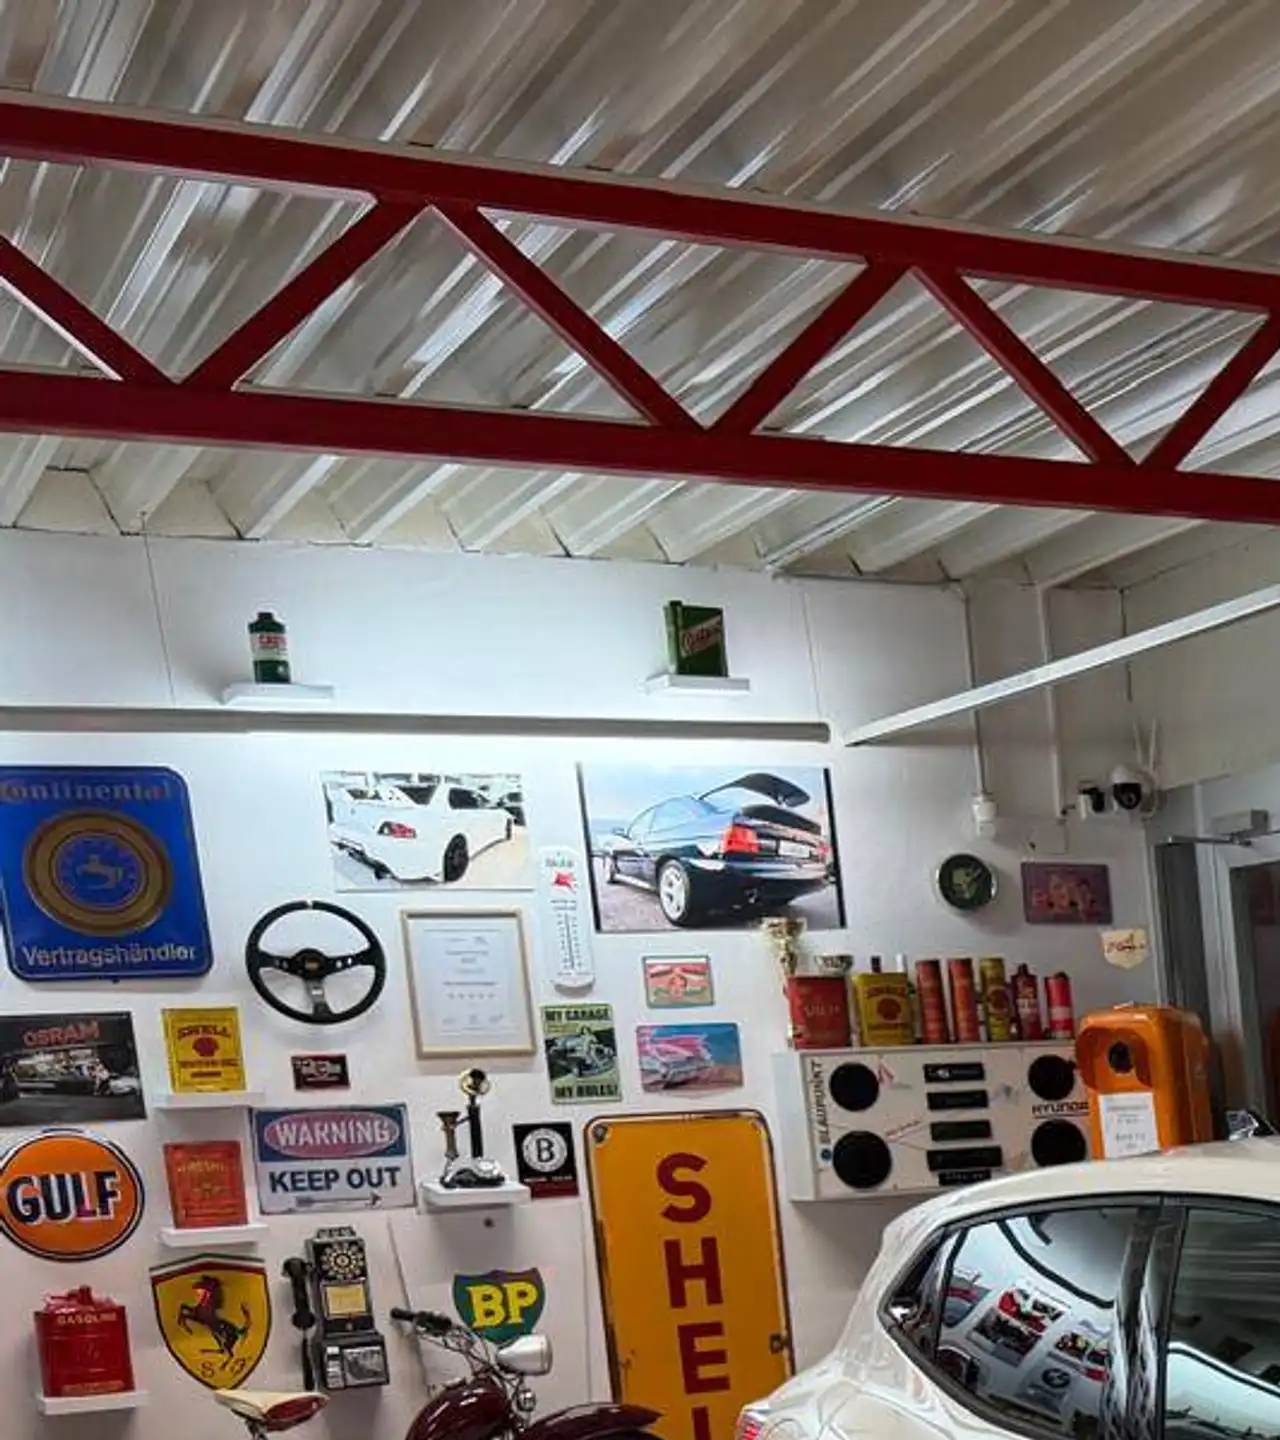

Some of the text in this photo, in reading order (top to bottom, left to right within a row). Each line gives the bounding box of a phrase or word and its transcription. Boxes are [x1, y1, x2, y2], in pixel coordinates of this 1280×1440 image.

[22, 942, 195, 968] Vertragshändler
[23, 1020, 101, 1047] OSRAM
[275, 1120, 390, 1147] WARNING
[269, 1166, 401, 1193] KEEP OUT
[7, 1170, 121, 1224] GULF
[466, 1281, 538, 1329] BP
